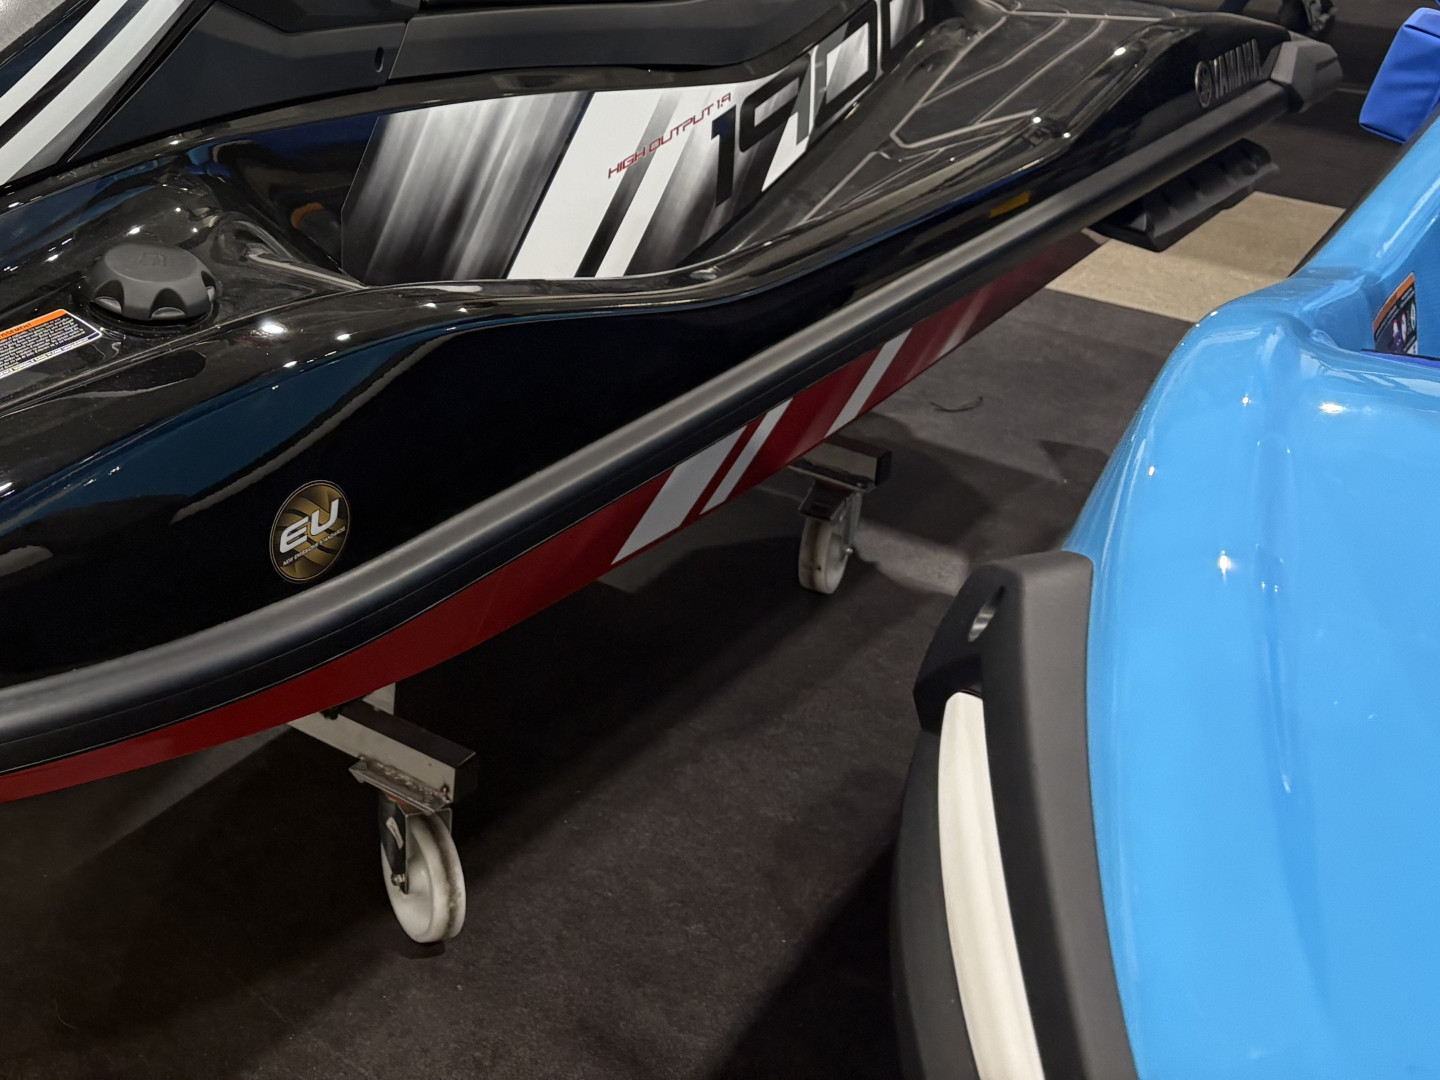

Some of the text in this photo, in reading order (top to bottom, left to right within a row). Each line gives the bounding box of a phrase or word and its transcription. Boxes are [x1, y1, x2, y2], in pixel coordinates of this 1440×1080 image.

[1209, 39, 1263, 99] YAMAHA
[608, 92, 732, 180] HIGH OUTPUT 1.9
[280, 499, 339, 553] EU
